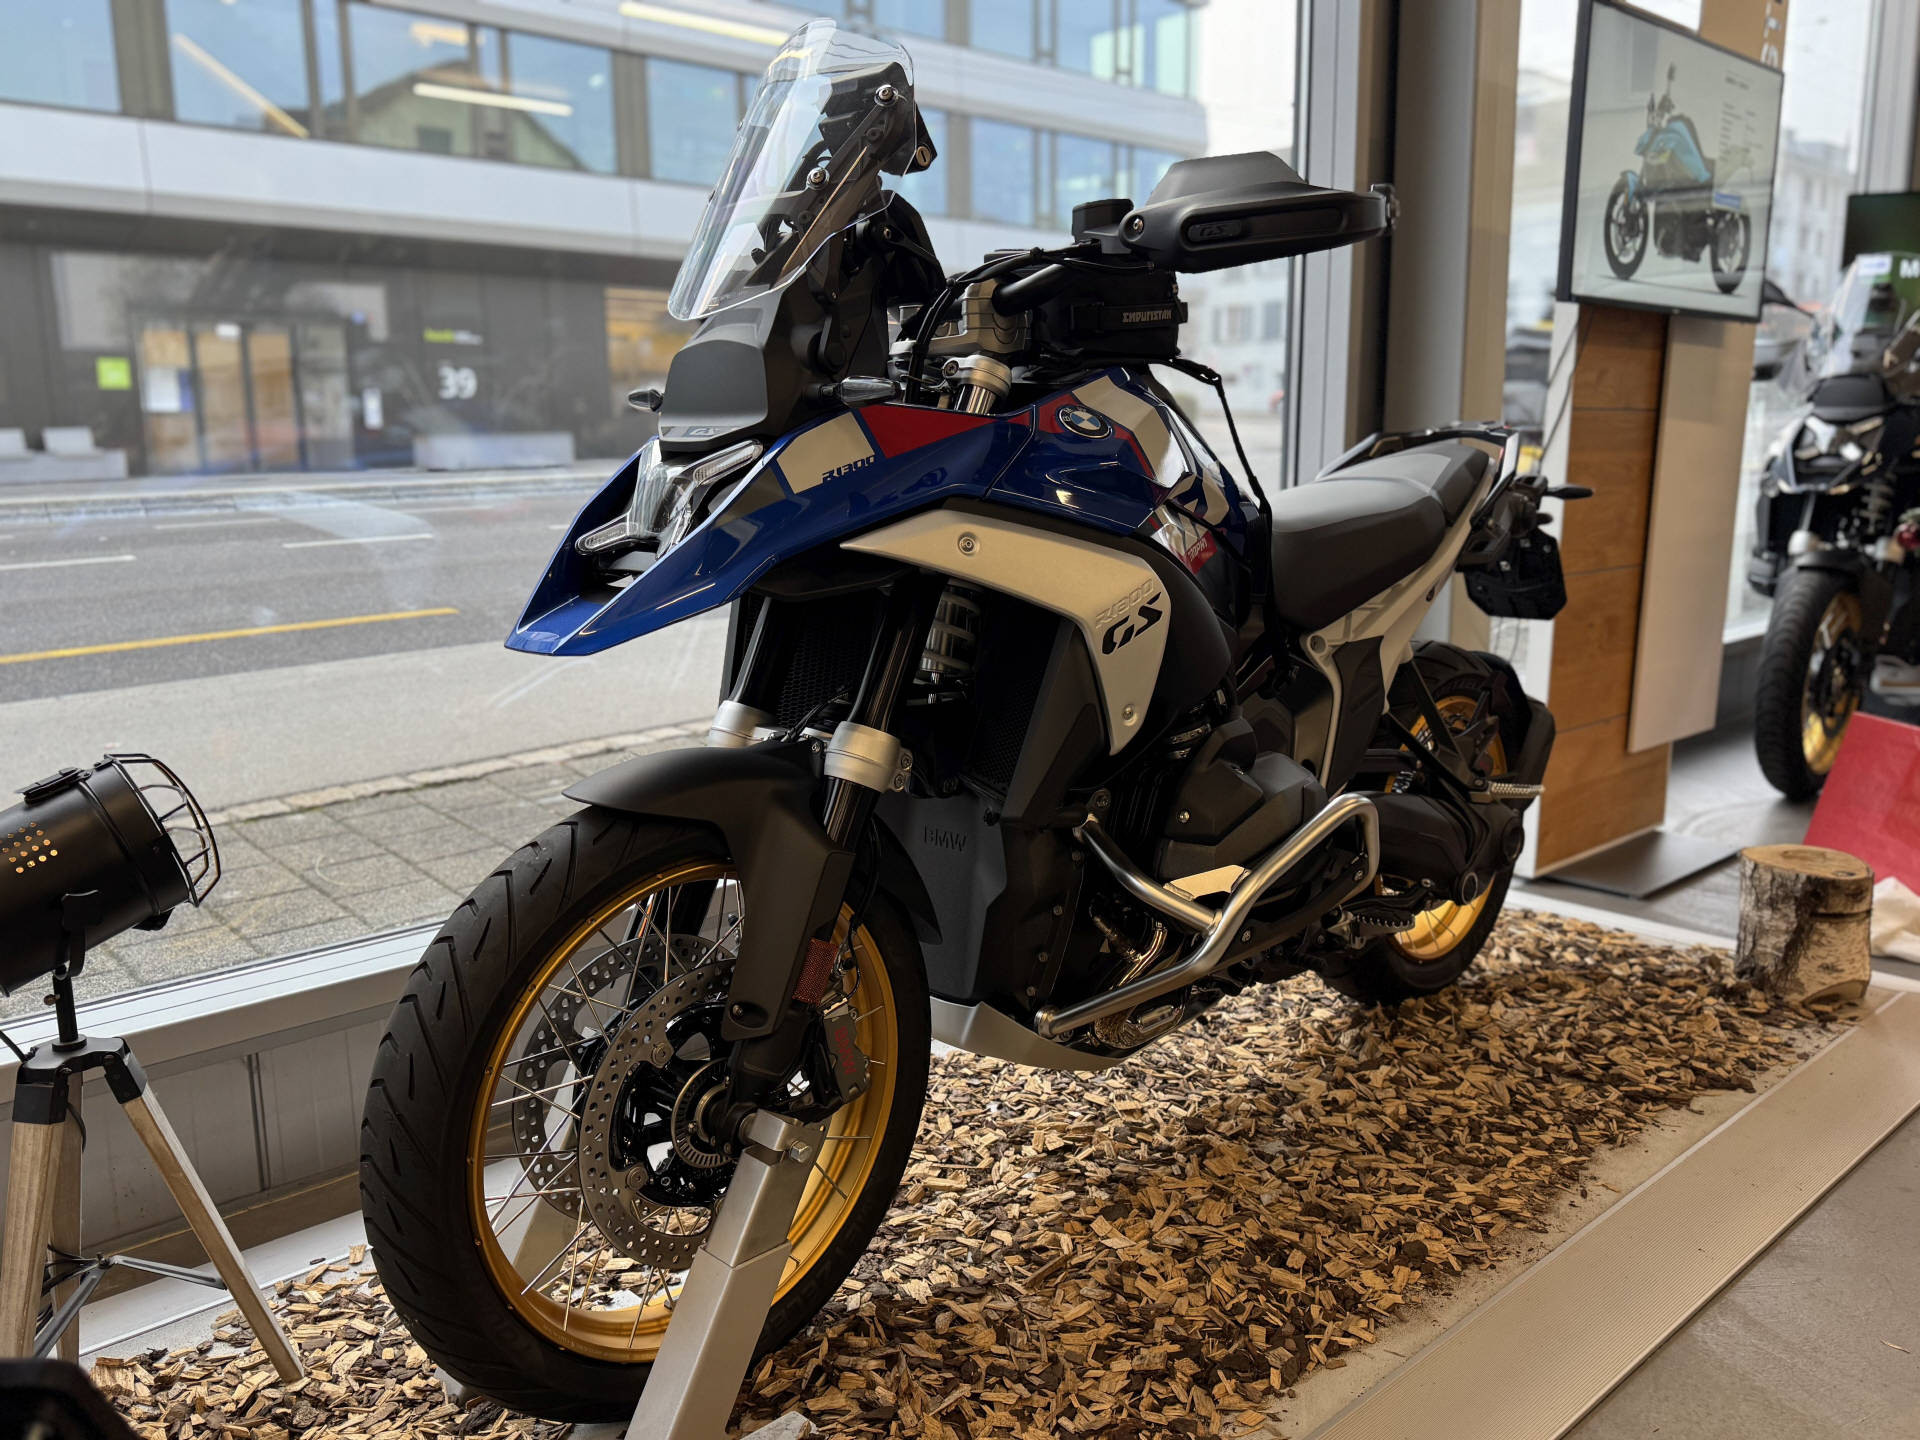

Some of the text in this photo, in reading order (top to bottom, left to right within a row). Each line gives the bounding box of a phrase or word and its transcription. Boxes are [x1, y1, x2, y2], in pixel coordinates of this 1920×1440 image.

[438, 366, 478, 400] 39
[1102, 592, 1163, 655] GS
[923, 823, 967, 852] BMW
